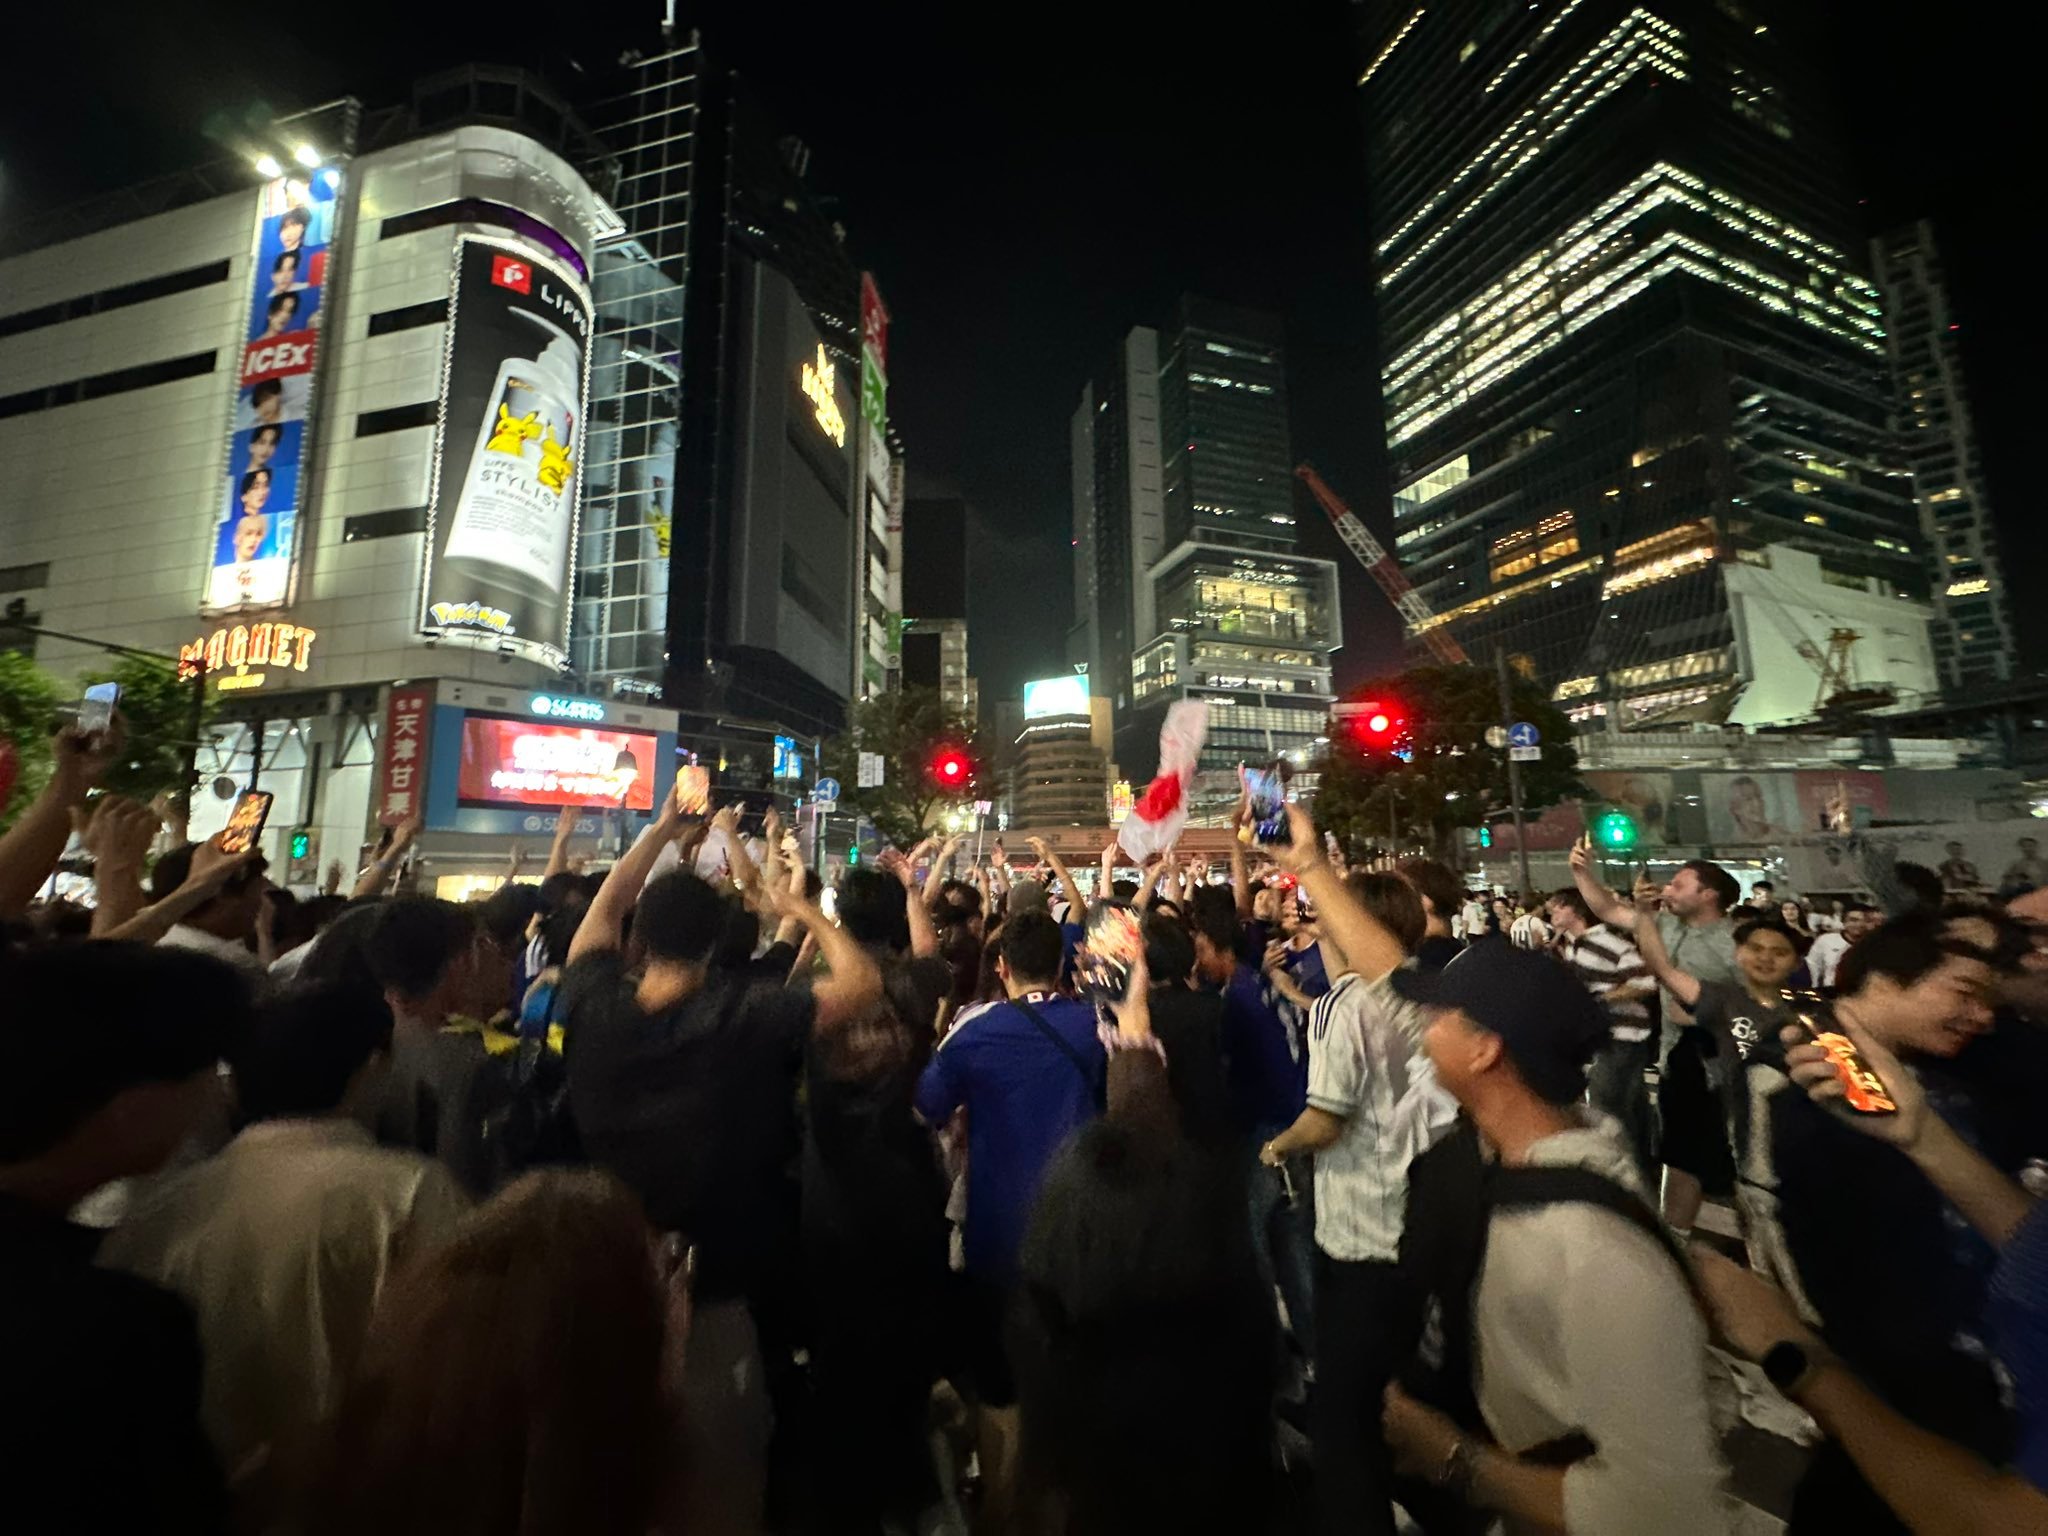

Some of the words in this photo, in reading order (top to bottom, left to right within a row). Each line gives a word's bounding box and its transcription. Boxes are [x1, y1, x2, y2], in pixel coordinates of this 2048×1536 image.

[541, 284, 587, 337] LIPPS
[480, 469, 561, 512] STYLIST
[178, 622, 316, 682] MAGNET
[385, 714, 420, 816] 天津甘栗
